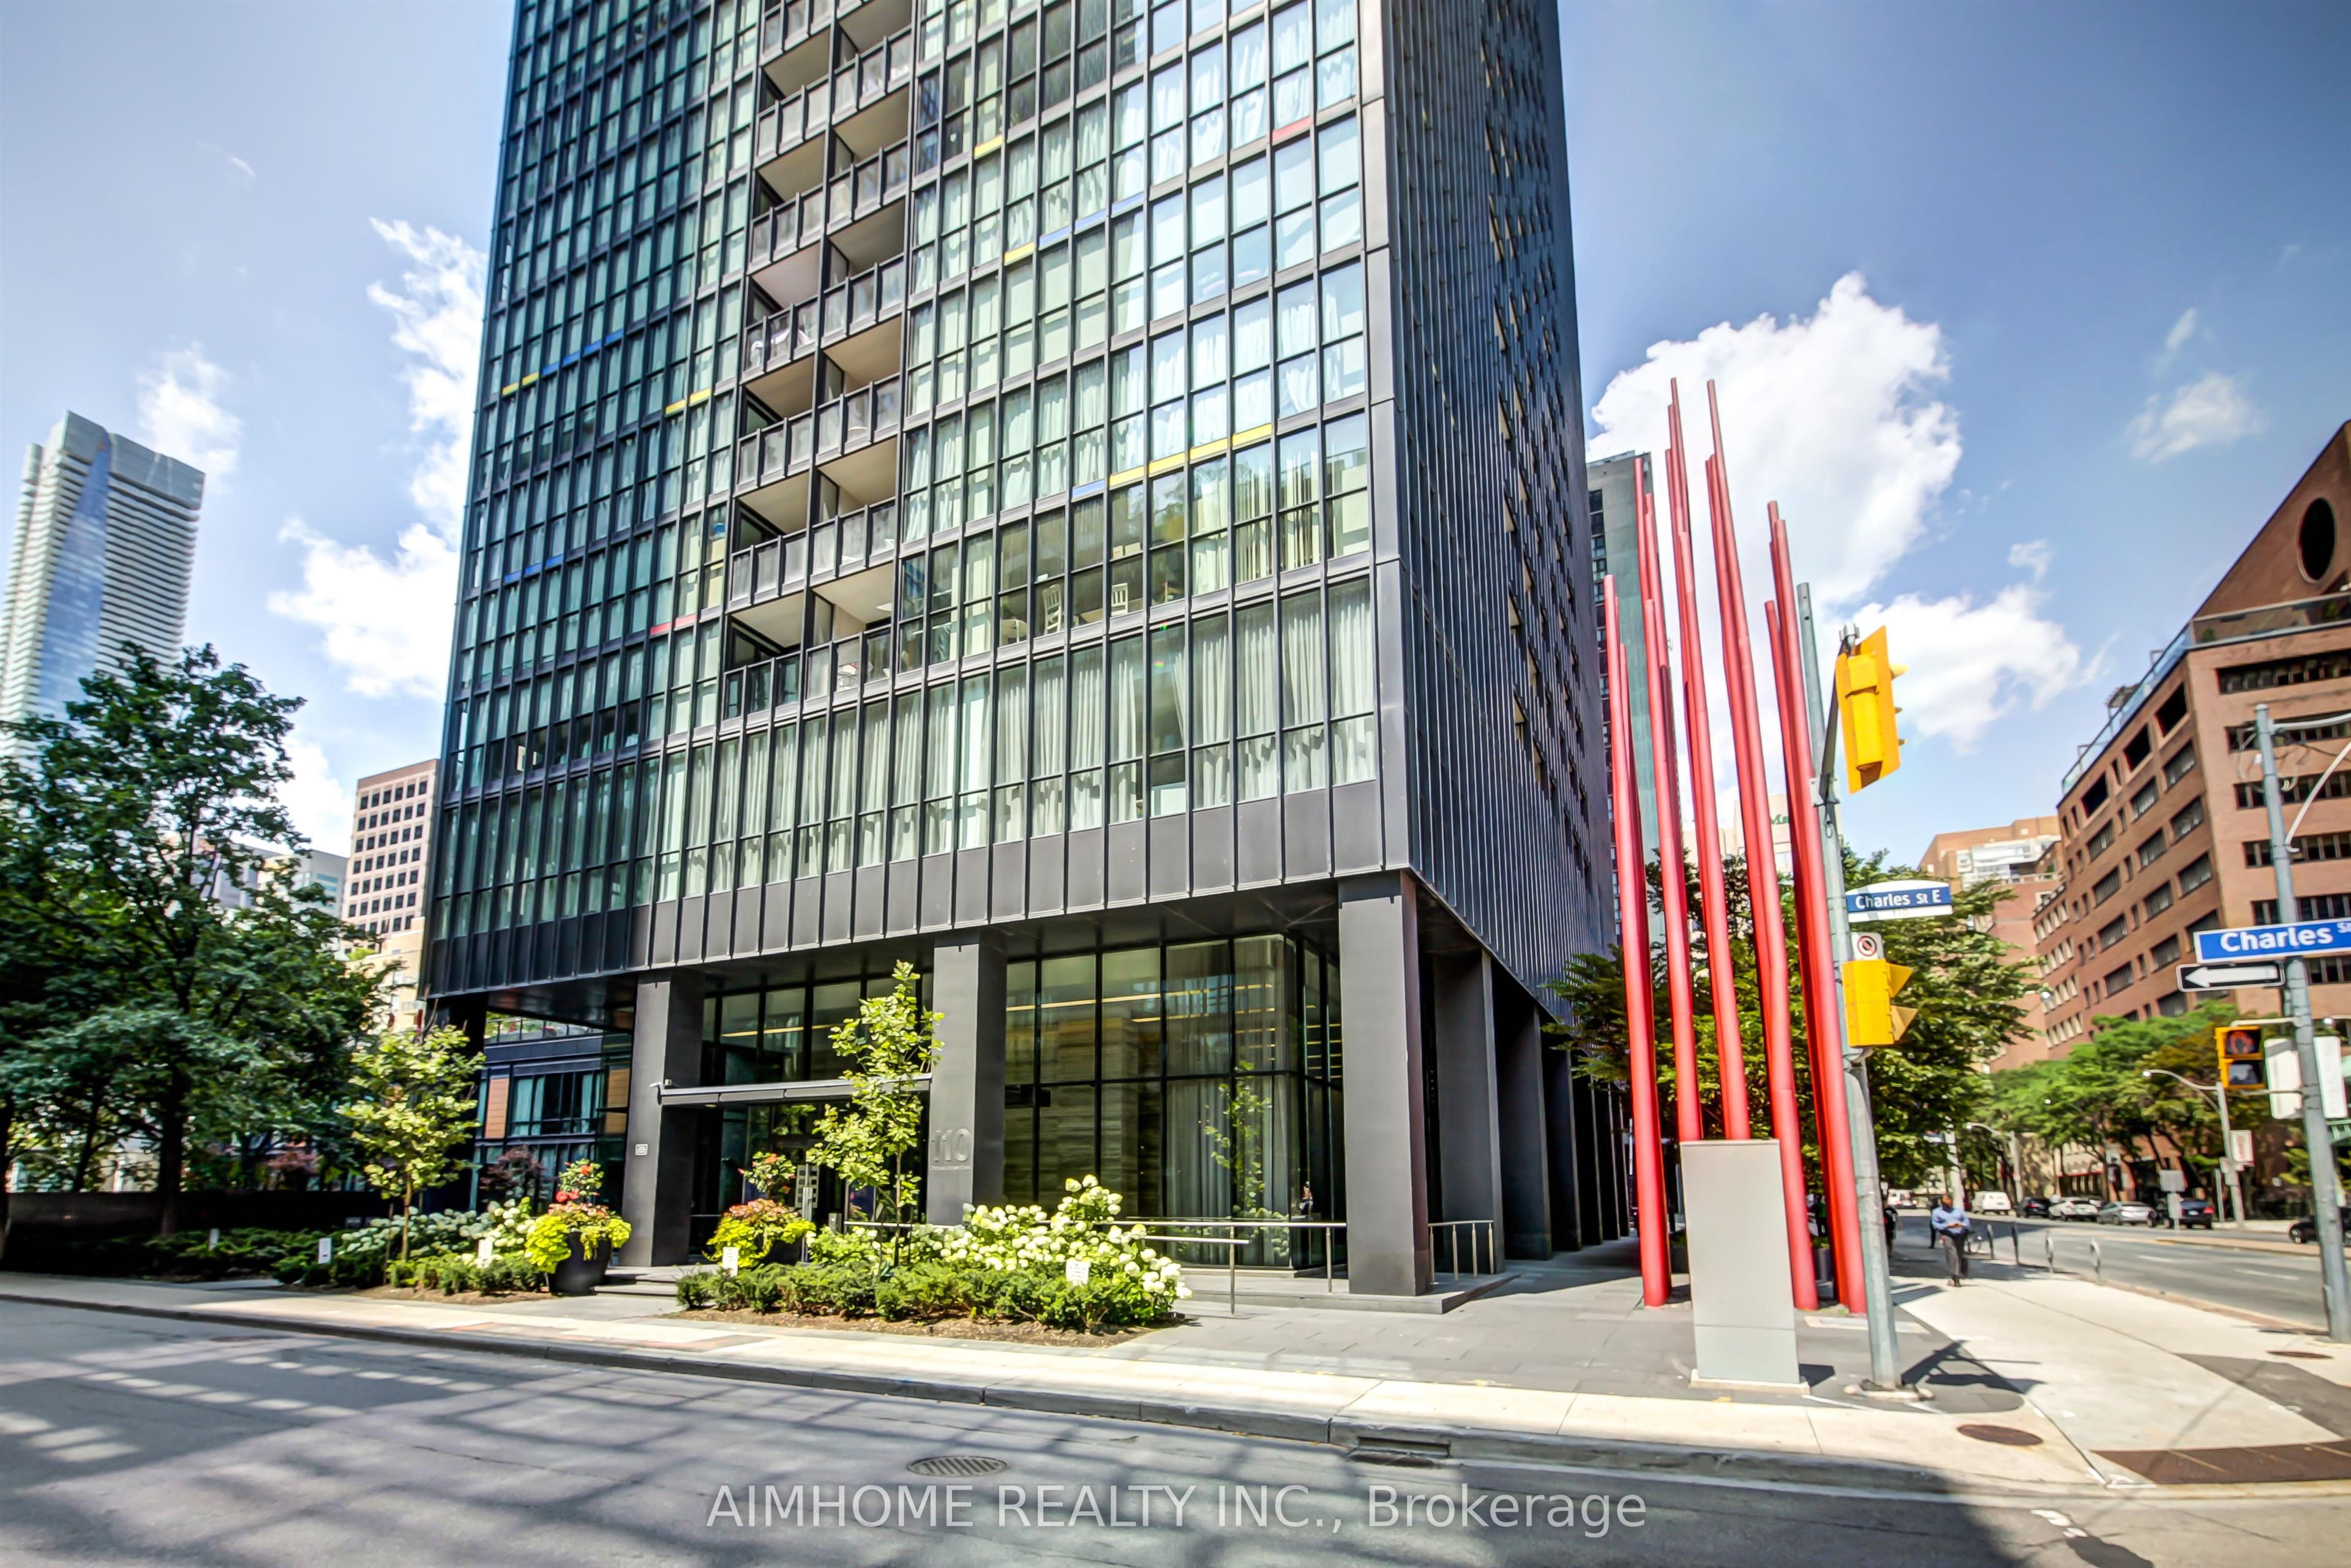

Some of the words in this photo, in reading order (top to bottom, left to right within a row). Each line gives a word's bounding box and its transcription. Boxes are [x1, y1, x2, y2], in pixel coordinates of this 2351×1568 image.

[1855, 893, 1911, 910] Charles
[1915, 892, 1929, 904] St
[1932, 889, 1942, 903] E
[2219, 926, 2334, 953] Charles
